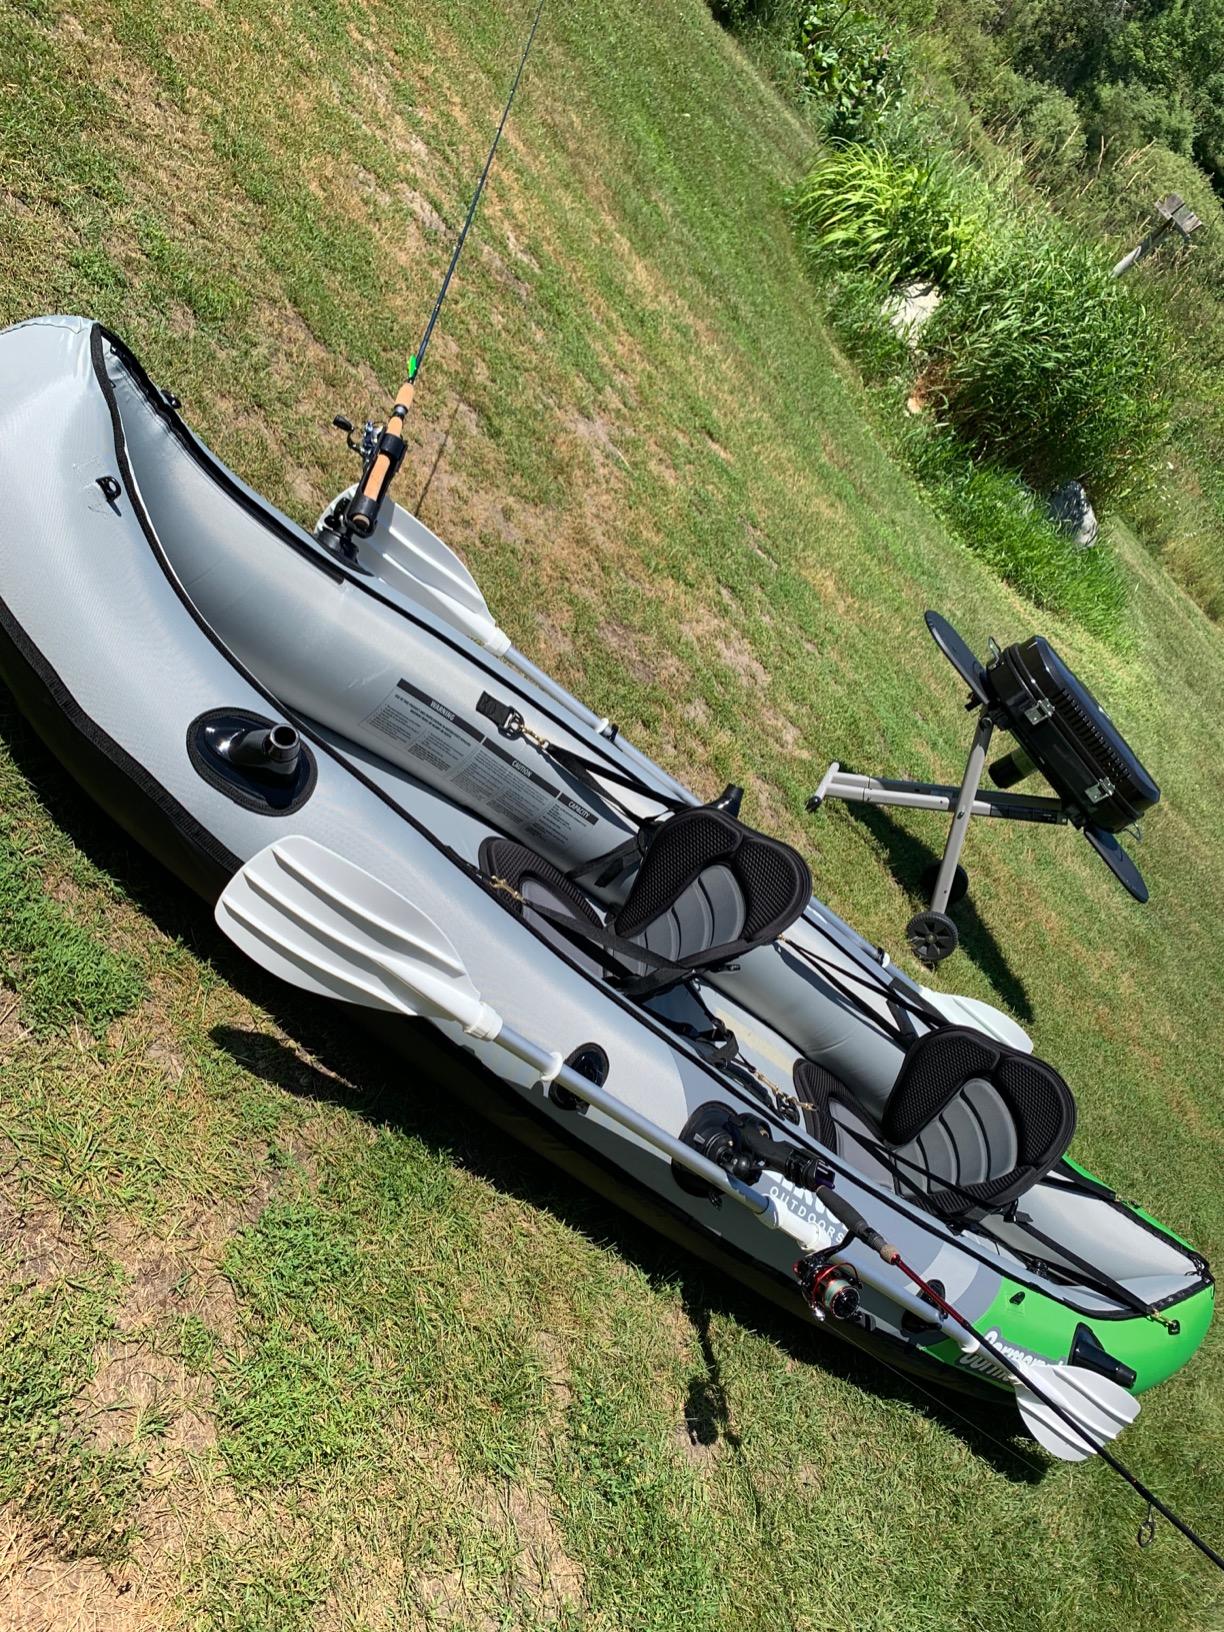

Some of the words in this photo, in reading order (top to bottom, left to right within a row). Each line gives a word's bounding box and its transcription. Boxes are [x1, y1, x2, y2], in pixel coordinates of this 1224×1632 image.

[430, 700, 455, 720] WARNING
[511, 760, 533, 777] CAUTION
[568, 801, 590, 818] CAPACITY
[769, 1186, 845, 1243] OUTDOORS
[959, 1330, 1064, 1381] Cormo
